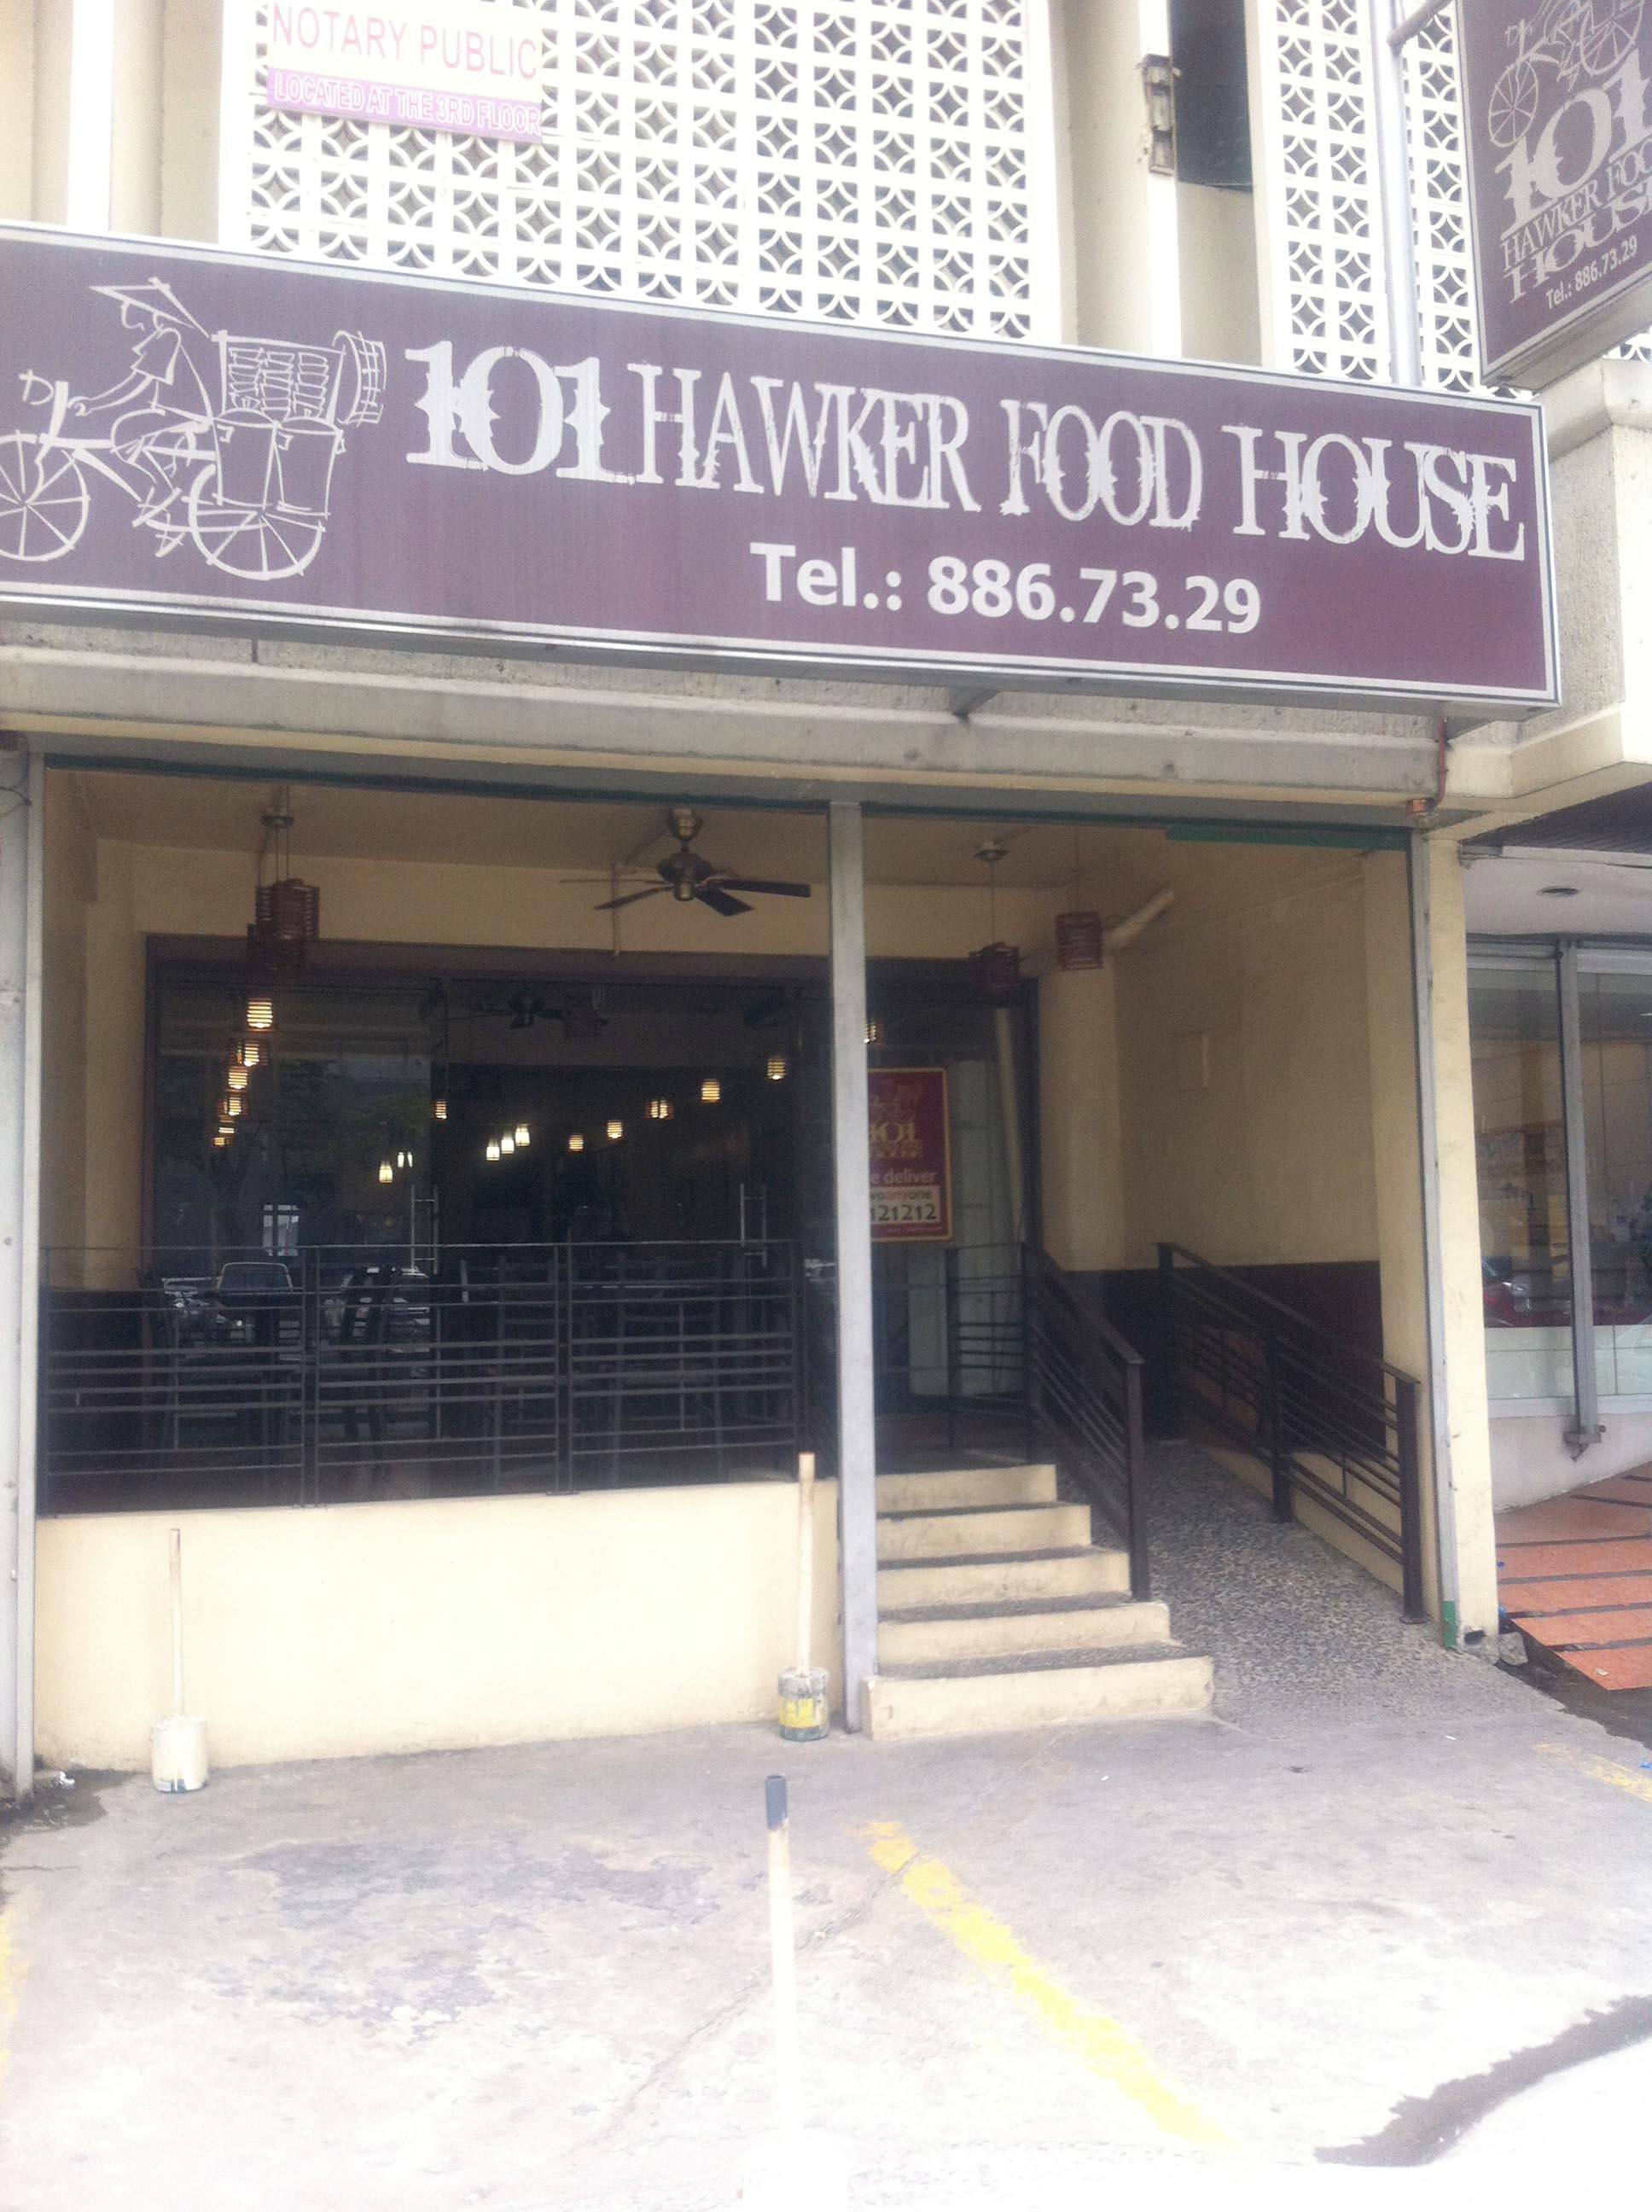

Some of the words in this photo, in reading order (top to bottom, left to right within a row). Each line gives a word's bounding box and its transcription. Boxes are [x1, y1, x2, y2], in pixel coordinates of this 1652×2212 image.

[272, 3, 407, 60] NOTARY
[420, 25, 538, 80] PUBLIC
[274, 72, 364, 111] LOCATED
[365, 86, 392, 116] AT
[396, 90, 433, 120] THE
[437, 96, 474, 125] 3RD
[476, 102, 543, 136] FLOOR
[1495, 48, 1652, 241] 101
[1501, 179, 1604, 272] HAWKER
[1605, 137, 1652, 202] FOO
[1503, 175, 1652, 304] HOUS
[1545, 272, 1572, 310] Tel.:
[1574, 234, 1637, 292] 886.73.29
[404, 341, 637, 486] 101
[627, 360, 981, 512] HAWKER
[999, 399, 1203, 531] FOOD
[1221, 423, 1526, 562] HOUSE
[749, 542, 902, 611] Tel.:
[927, 556, 1261, 633] 886.73.29
[883, 1167, 936, 1185] deliver
